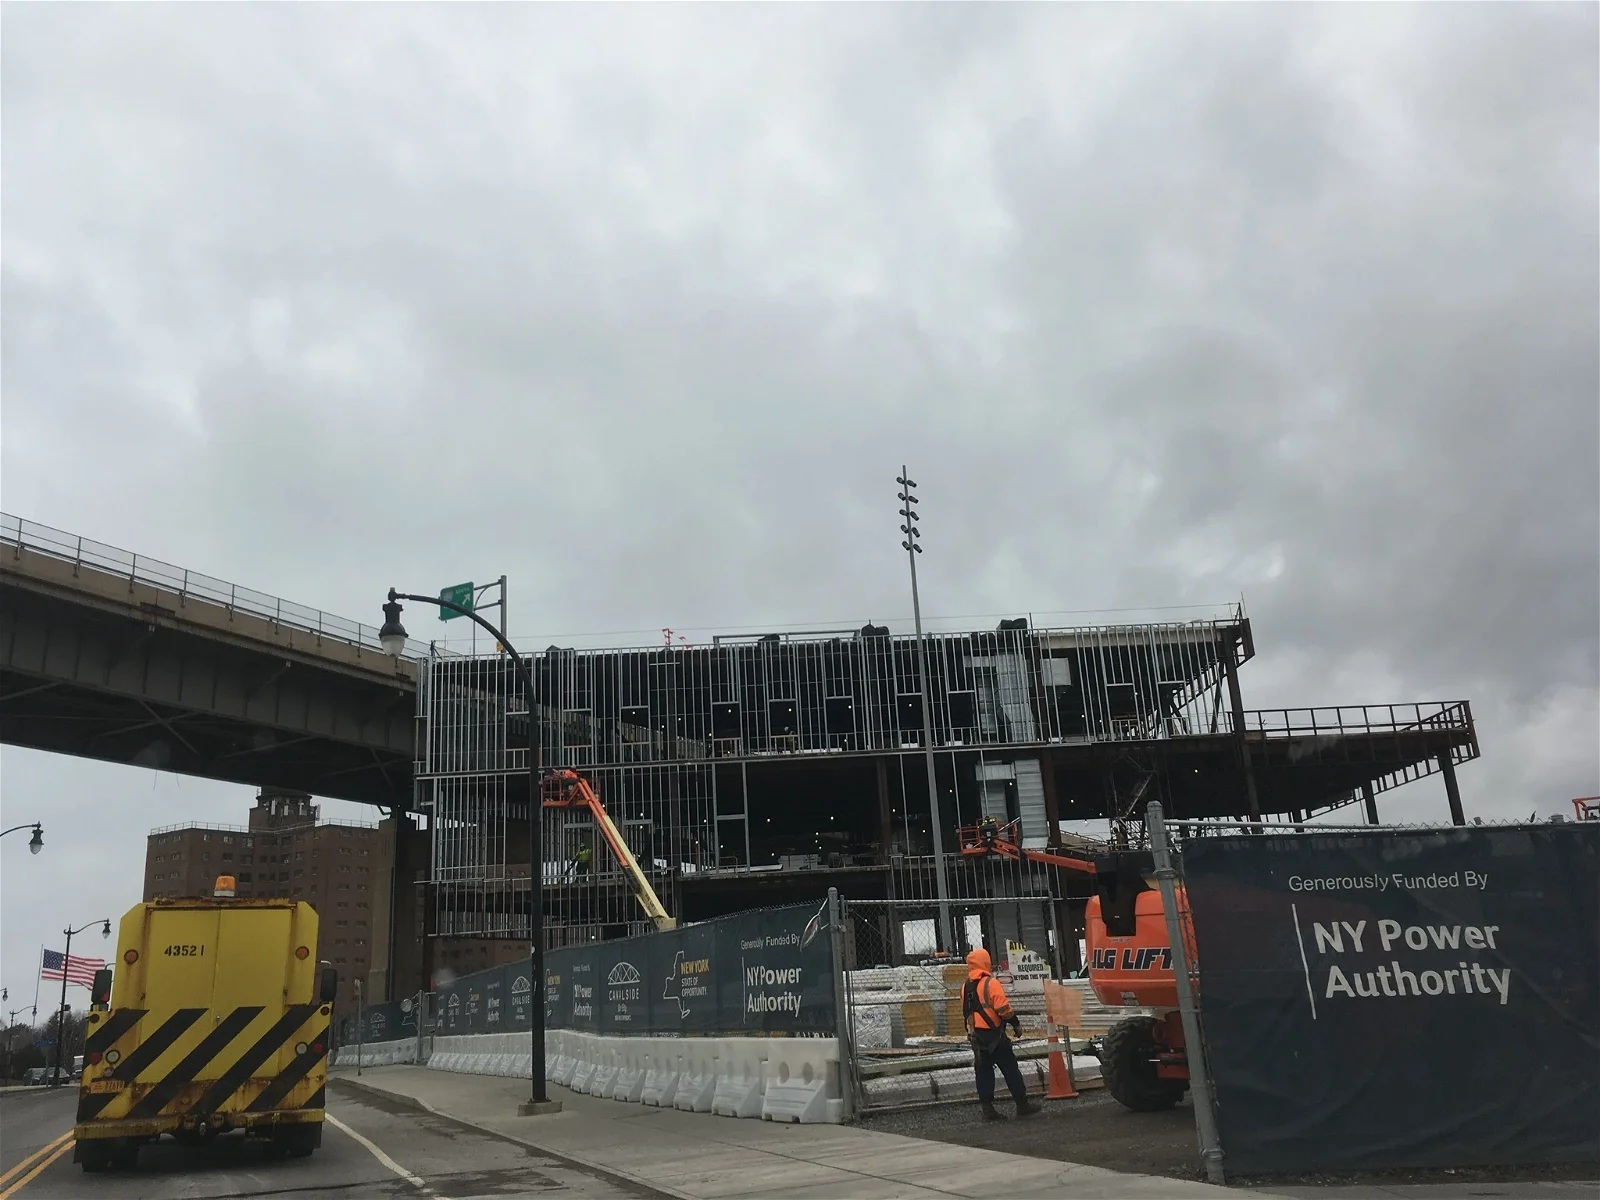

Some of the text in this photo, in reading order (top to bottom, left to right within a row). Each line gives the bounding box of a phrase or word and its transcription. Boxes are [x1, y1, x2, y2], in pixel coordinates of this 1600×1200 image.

[1288, 870, 1488, 892] Generously Funded By
[765, 934, 790, 947] Funded
[791, 933, 801, 947] By
[1313, 918, 1500, 954] NY Power
[164, 944, 205, 957] 43521
[680, 958, 710, 975] NEW YORK
[746, 965, 802, 987] NY Power
[1017, 963, 1044, 973] REQUIRED
[1325, 960, 1512, 1005] Authority
[608, 988, 640, 1001] CANALSIDE
[747, 991, 802, 1018] Authority
